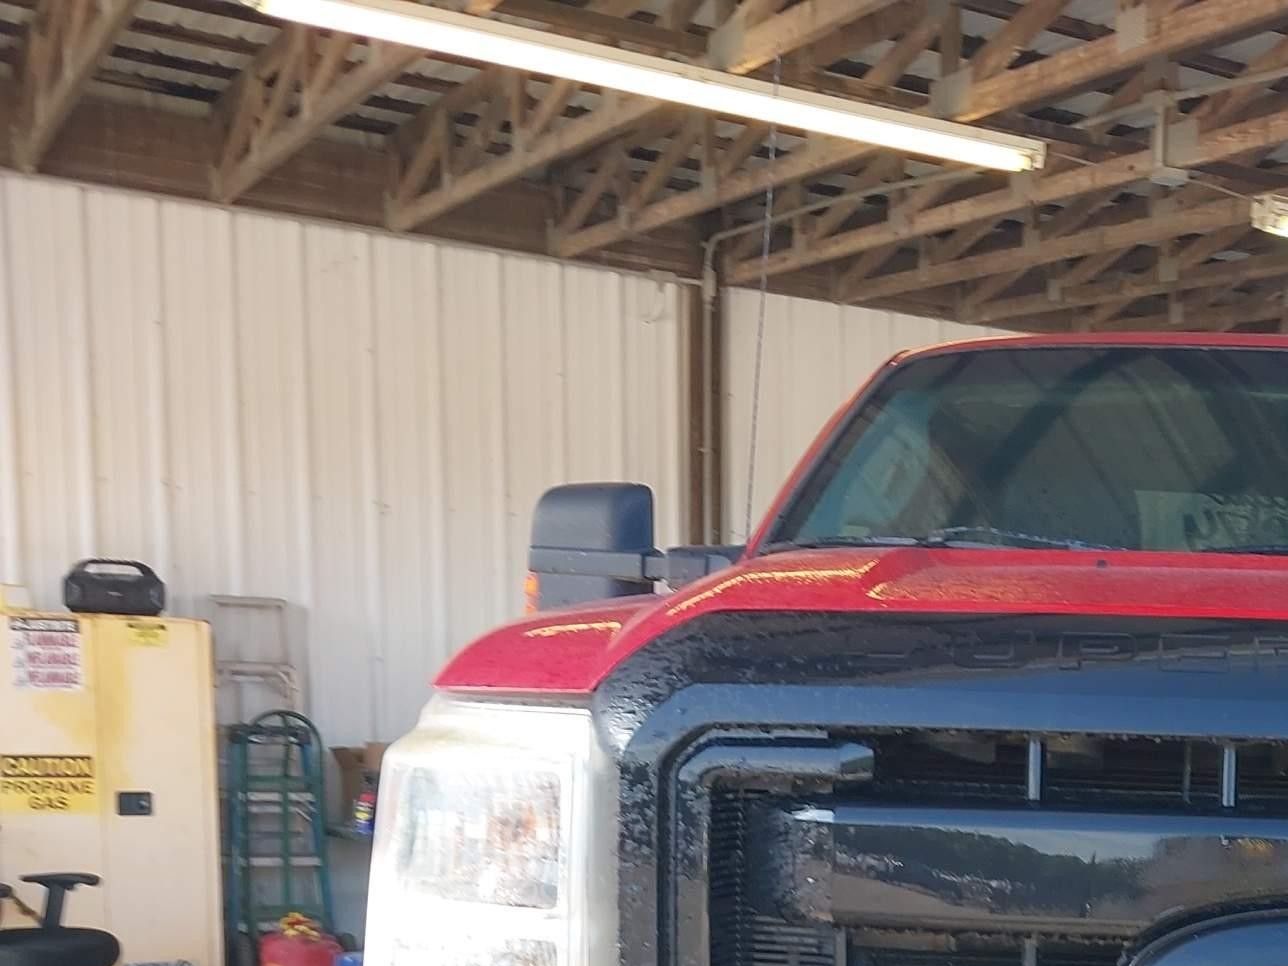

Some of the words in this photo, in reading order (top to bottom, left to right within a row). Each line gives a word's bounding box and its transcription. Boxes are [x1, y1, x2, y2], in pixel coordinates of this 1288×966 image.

[0, 757, 92, 777] CAUTION
[0, 780, 95, 795] PROPANE
[28, 795, 70, 811] GAS
